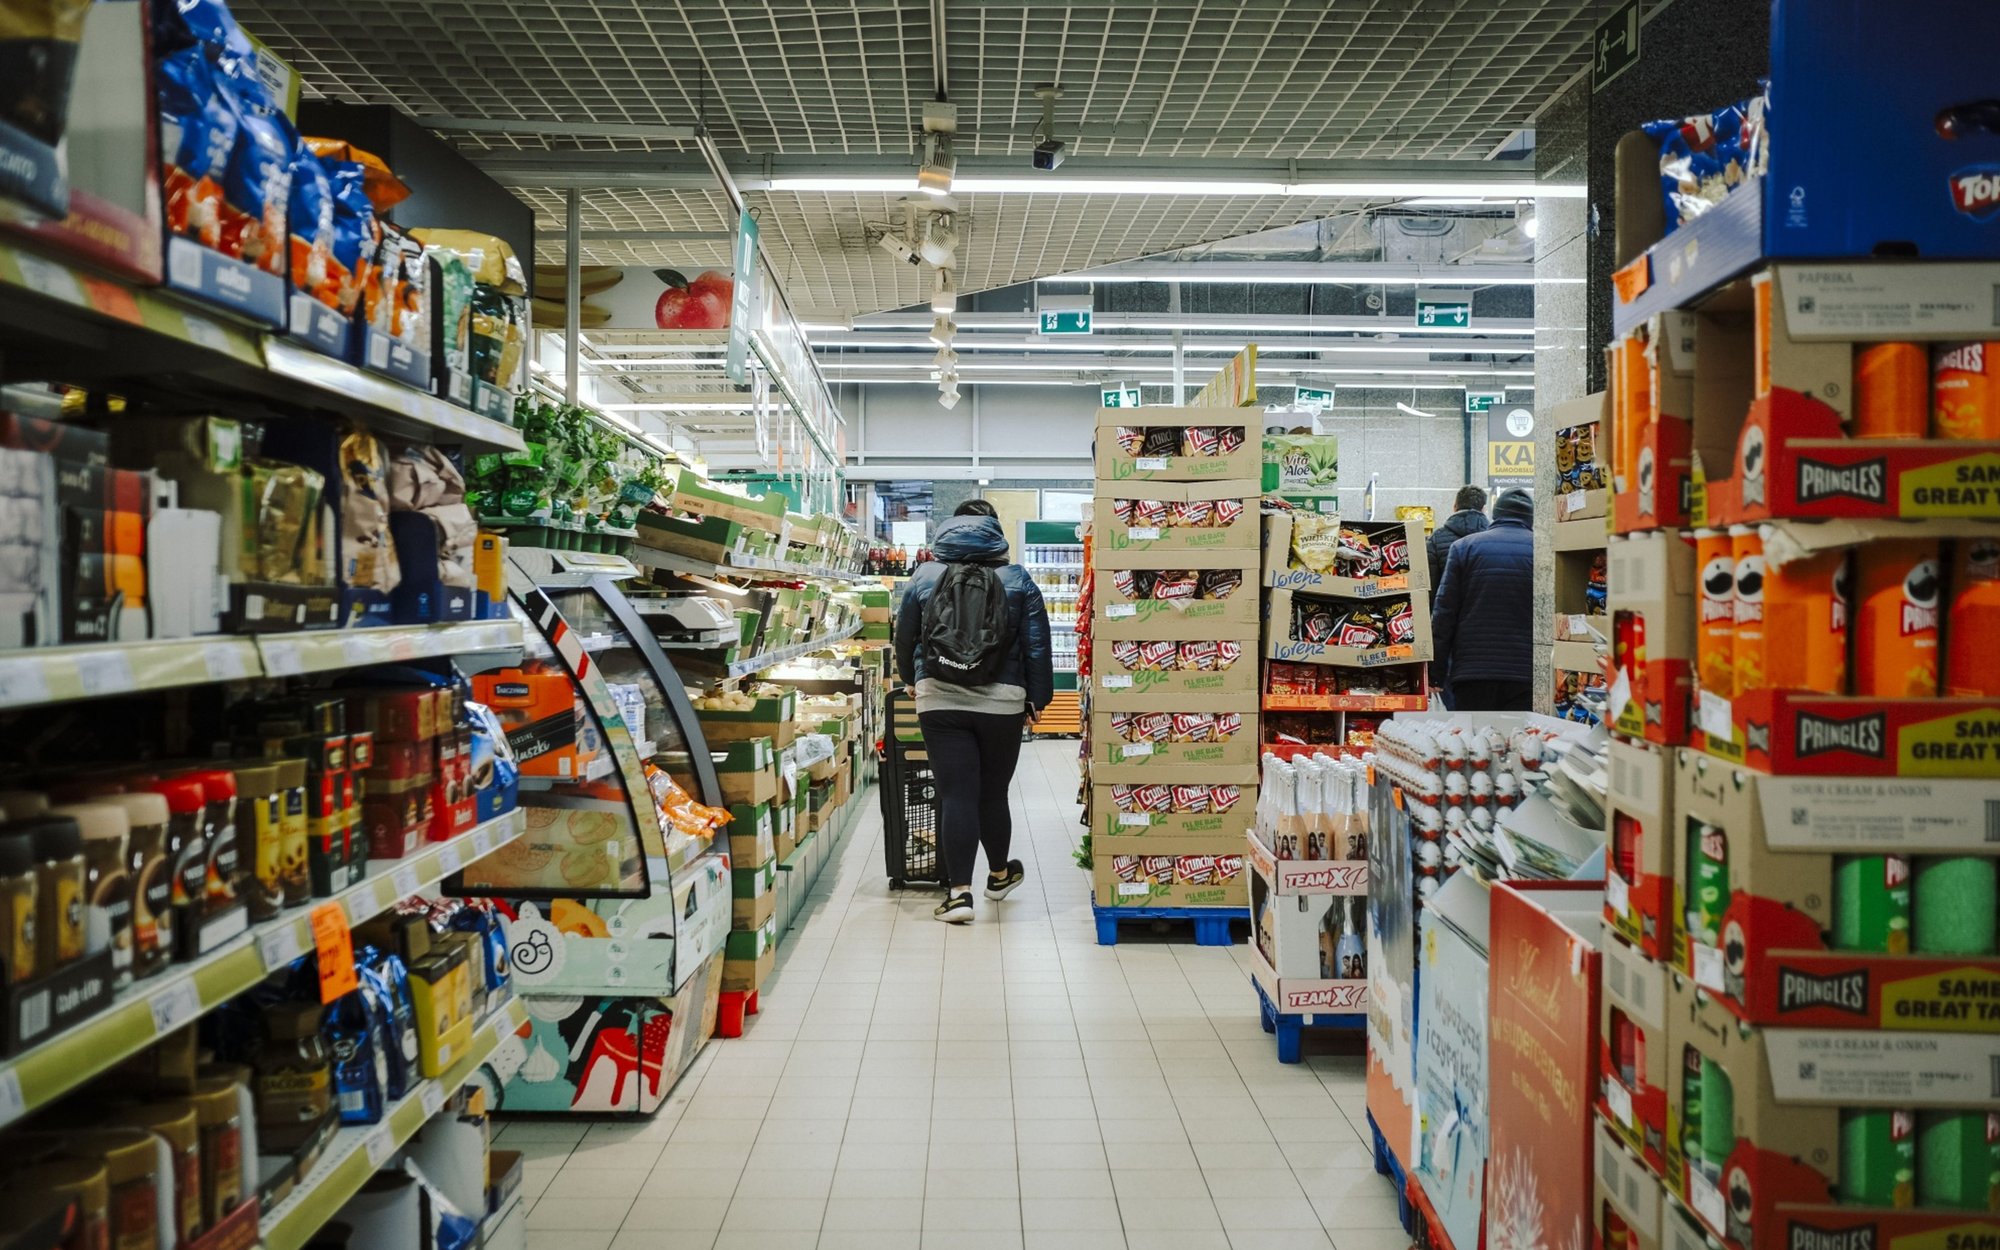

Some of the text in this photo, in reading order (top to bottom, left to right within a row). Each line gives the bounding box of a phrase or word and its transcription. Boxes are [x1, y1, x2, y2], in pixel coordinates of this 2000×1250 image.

[1797, 272, 1854, 283] PAPRIKA
[1285, 454, 1309, 466] Vita
[1494, 445, 1534, 465] KA
[1285, 465, 1310, 476] Aloe
[1802, 464, 1880, 498] PRINGLES
[1913, 487, 1990, 505] GREAT
[1272, 570, 1322, 590] Lorenz
[1274, 641, 1325, 661] Lorenz
[938, 655, 969, 670] Reebok
[1801, 718, 1880, 752] PRINGLES
[1911, 742, 1988, 760] GREAT
[1827, 784, 1873, 796] CREAM
[1876, 785, 1886, 797] &
[1888, 785, 1932, 797] ONION
[1783, 973, 1863, 1009] PRINGLES
[1939, 979, 2000, 998] SAME
[1894, 1000, 1972, 1019] GREAT
[1835, 1038, 1880, 1050] CREAM
[1882, 1039, 1893, 1051] &
[1896, 1040, 1939, 1052] ONION
[1946, 1233, 2000, 1250] SAM
